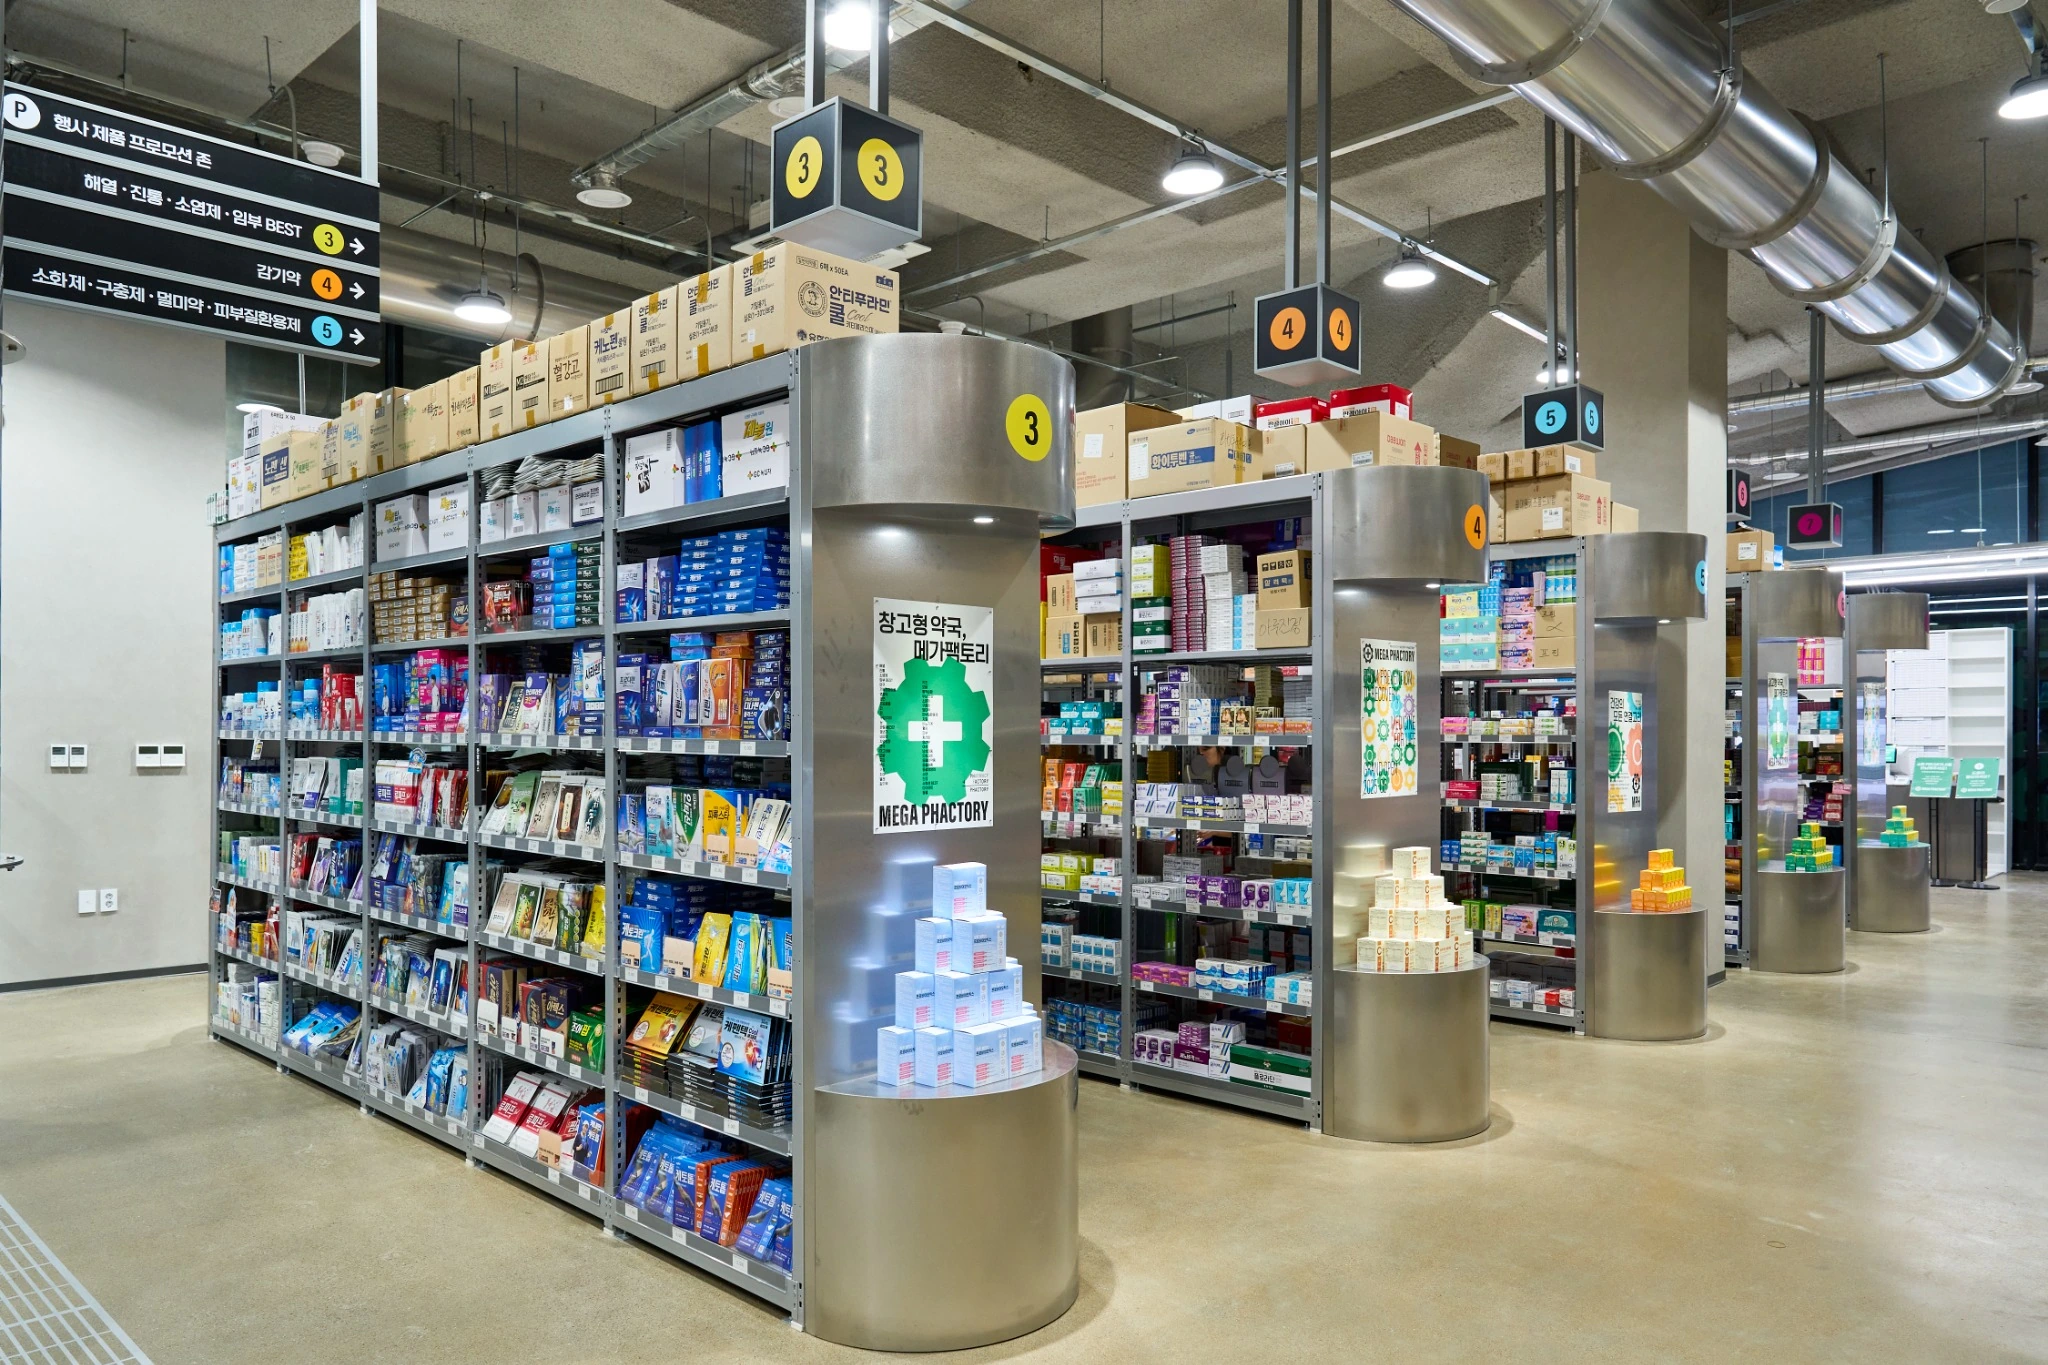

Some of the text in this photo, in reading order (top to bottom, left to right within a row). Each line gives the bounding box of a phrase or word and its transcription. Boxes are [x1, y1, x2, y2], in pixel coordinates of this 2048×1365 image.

[15, 101, 28, 118] P
[54, 113, 214, 170] 행사 제품 프로모션 존
[798, 152, 809, 184] 3
[873, 154, 888, 187] 3
[84, 174, 118, 196] 해열
[130, 184, 164, 207] 진통
[175, 197, 222, 221] 소염제
[265, 221, 303, 239] BEST
[325, 231, 335, 248] 3
[257, 264, 303, 287] 감기약
[323, 277, 332, 293] 4
[32, 268, 302, 333] 소화제 구충제 멀미약 피부질환용제
[829, 285, 890, 313] 안티푸라민
[829, 302, 845, 327] 쿨
[323, 323, 333, 339] 5
[1282, 317, 1294, 340] 4
[1336, 319, 1344, 341] 4
[1024, 411, 1038, 446] 3
[1546, 409, 1556, 427] 5
[1589, 410, 1595, 427] 5
[1151, 449, 1188, 471] 화이투벤
[1739, 487, 1745, 501] 6
[1473, 516, 1481, 540] 4
[1806, 518, 1813, 531] 7
[878, 610, 967, 641] 창고형 약국,
[914, 638, 989, 665] 메가팩토리
[1374, 648, 1415, 662] MEGA PHACTORY
[879, 800, 989, 828] MEGA PHACTORY
